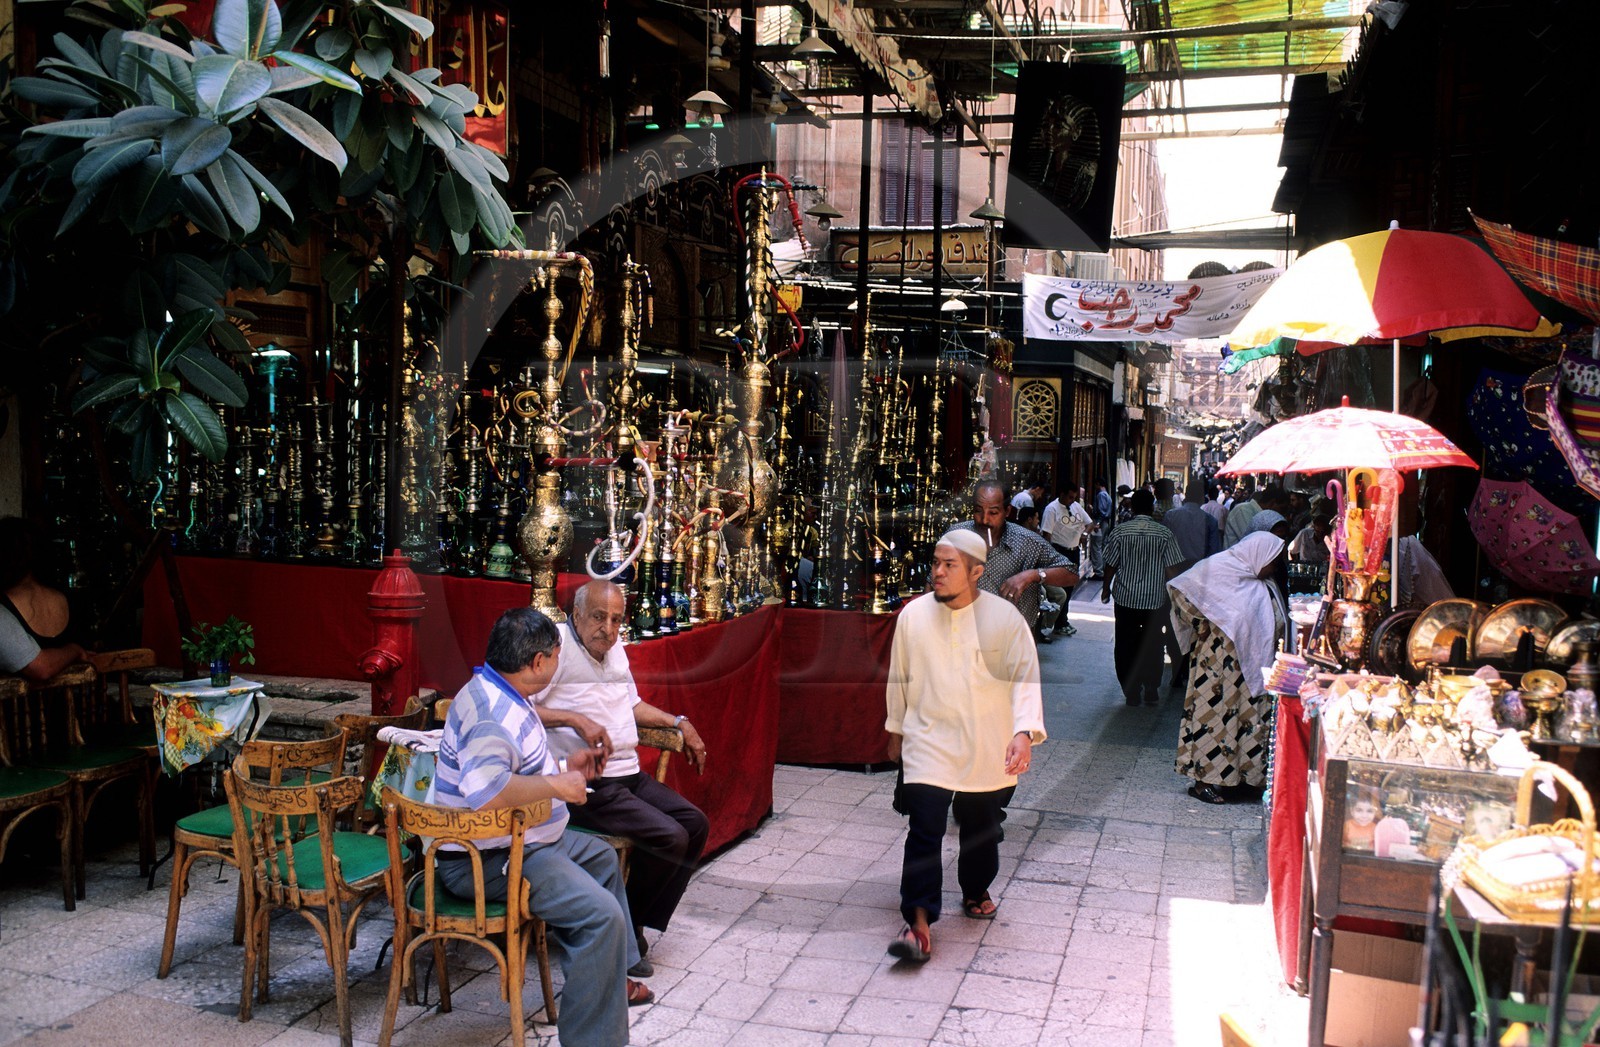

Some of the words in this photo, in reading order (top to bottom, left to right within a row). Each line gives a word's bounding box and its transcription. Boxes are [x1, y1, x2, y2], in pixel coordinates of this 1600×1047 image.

[903, 246, 945, 273] ور
[1078, 287, 1141, 334] رجب
[1133, 284, 1203, 335] محمد
